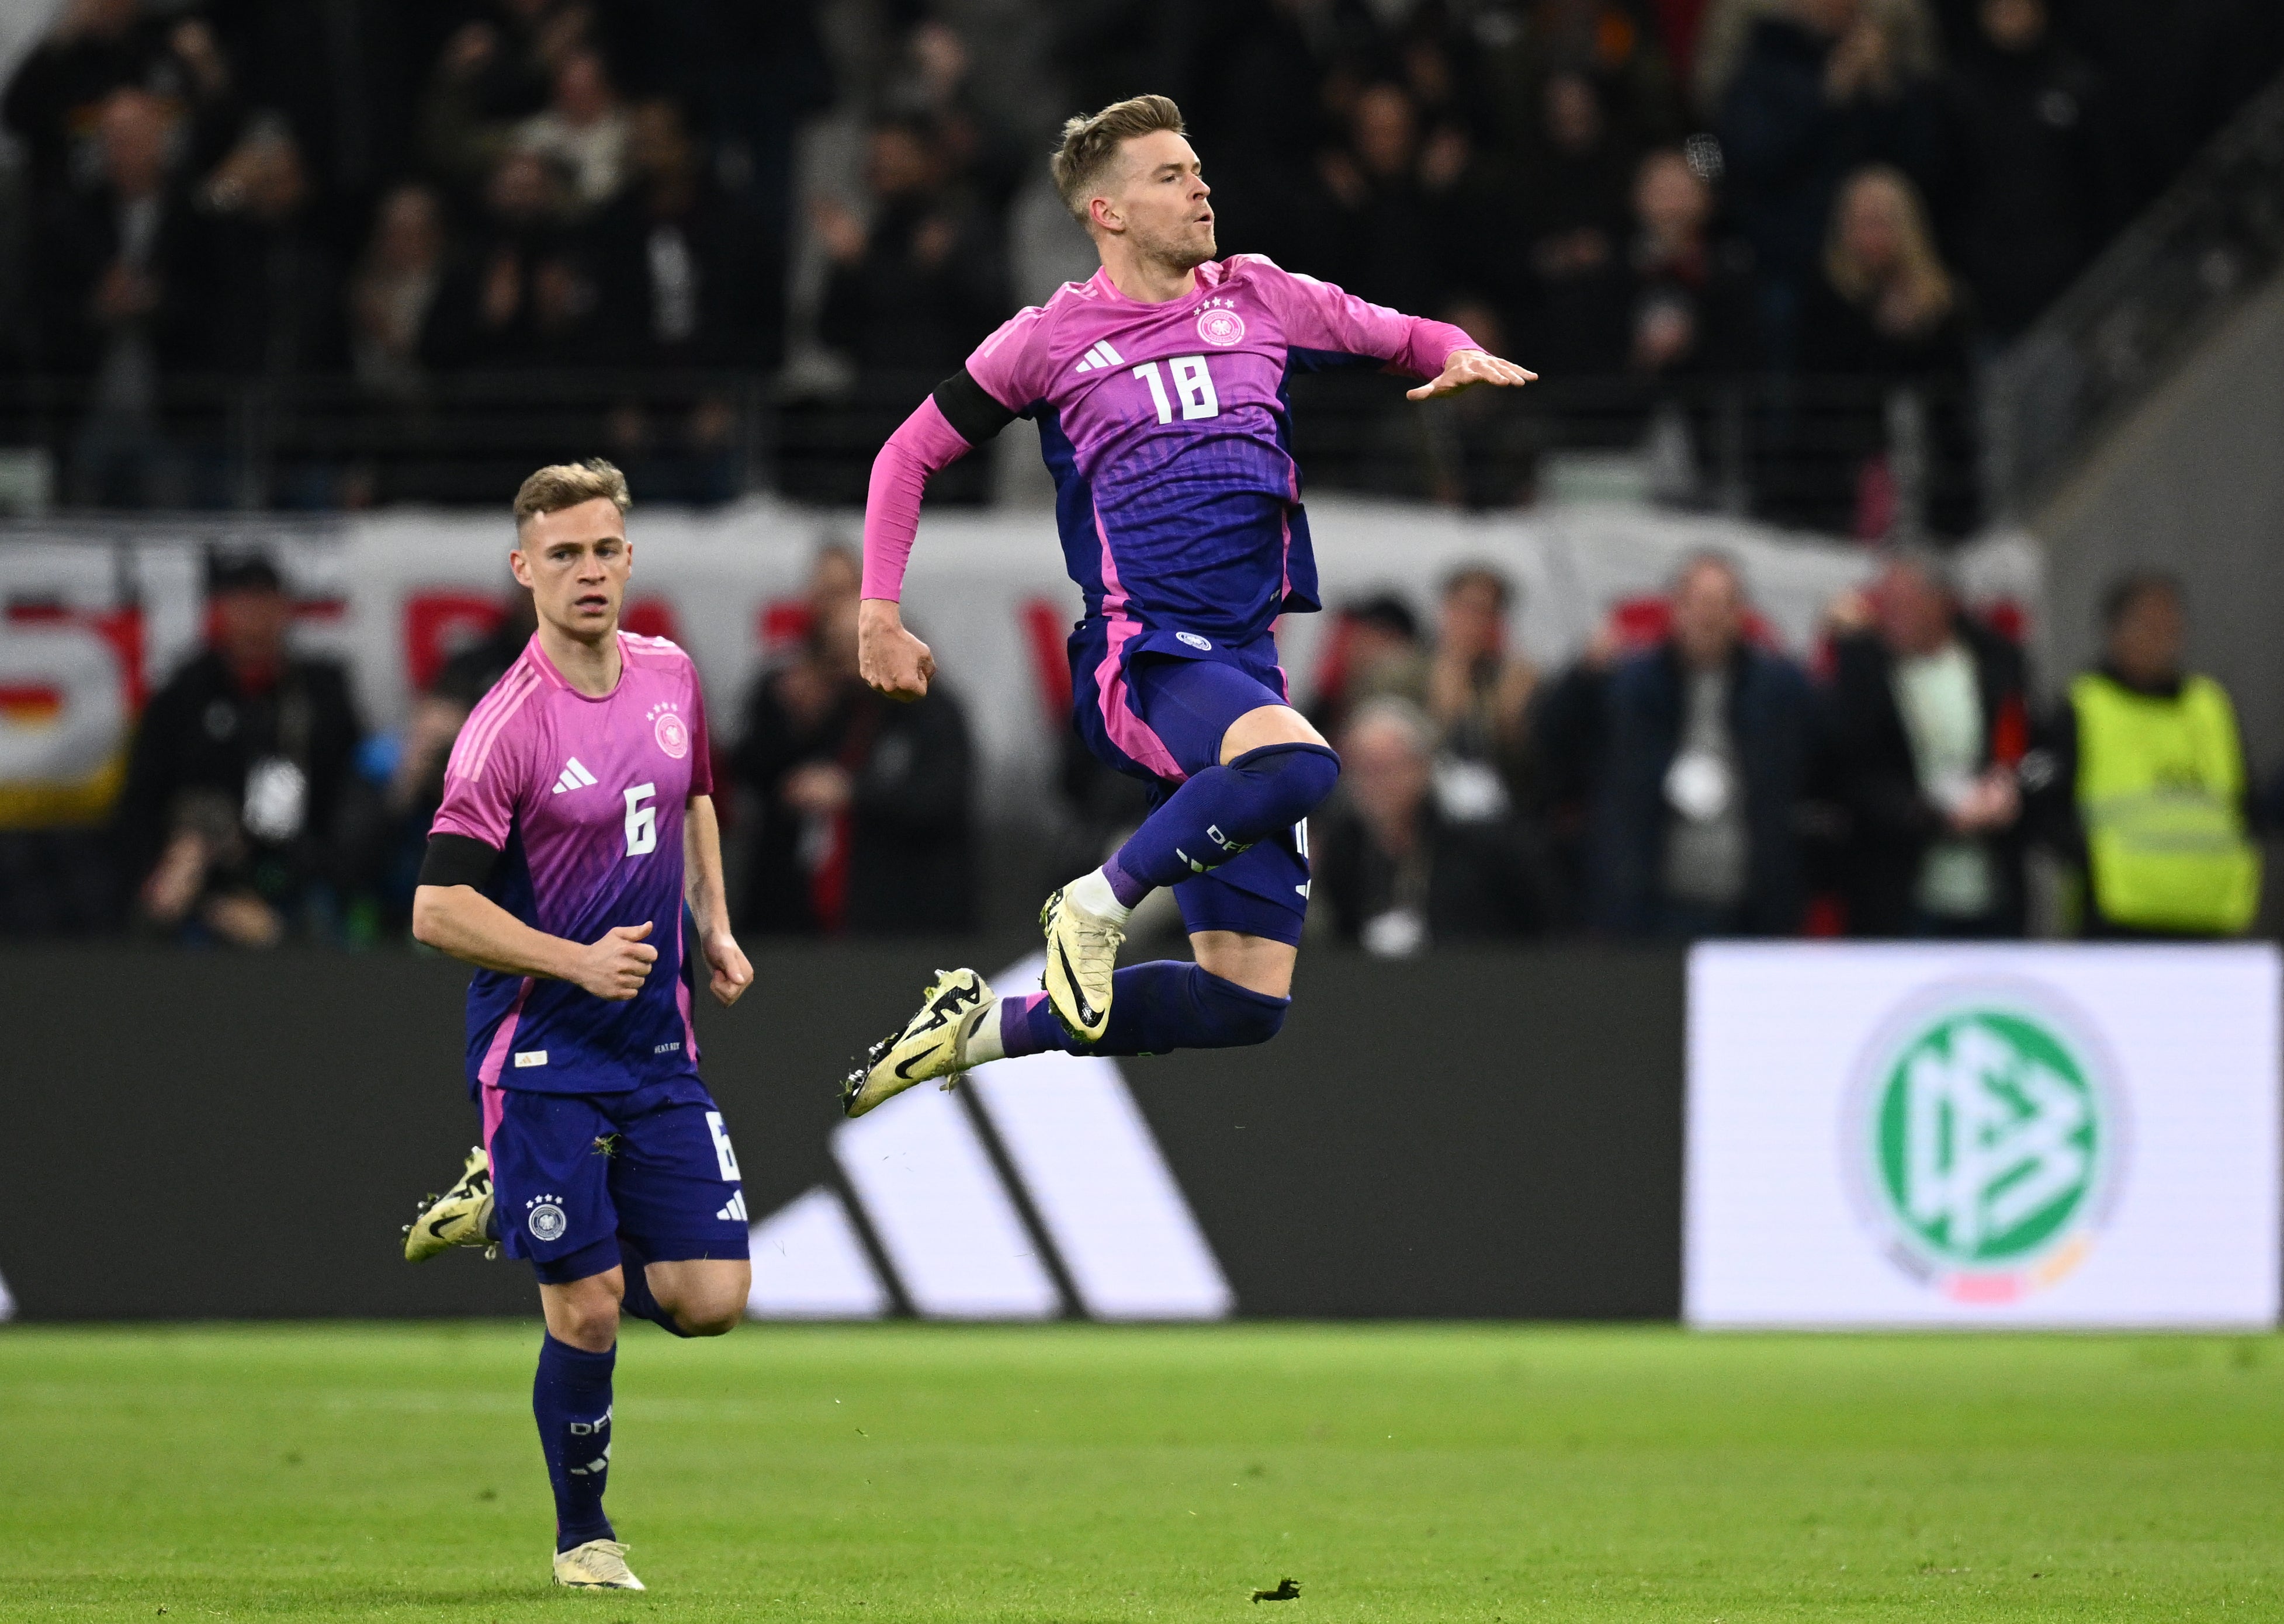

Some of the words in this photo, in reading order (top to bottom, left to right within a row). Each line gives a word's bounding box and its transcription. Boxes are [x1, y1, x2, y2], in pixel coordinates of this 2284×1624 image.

[1132, 355, 1218, 425] 18
[623, 783, 657, 856] 6
[705, 1111, 741, 1181] 6
